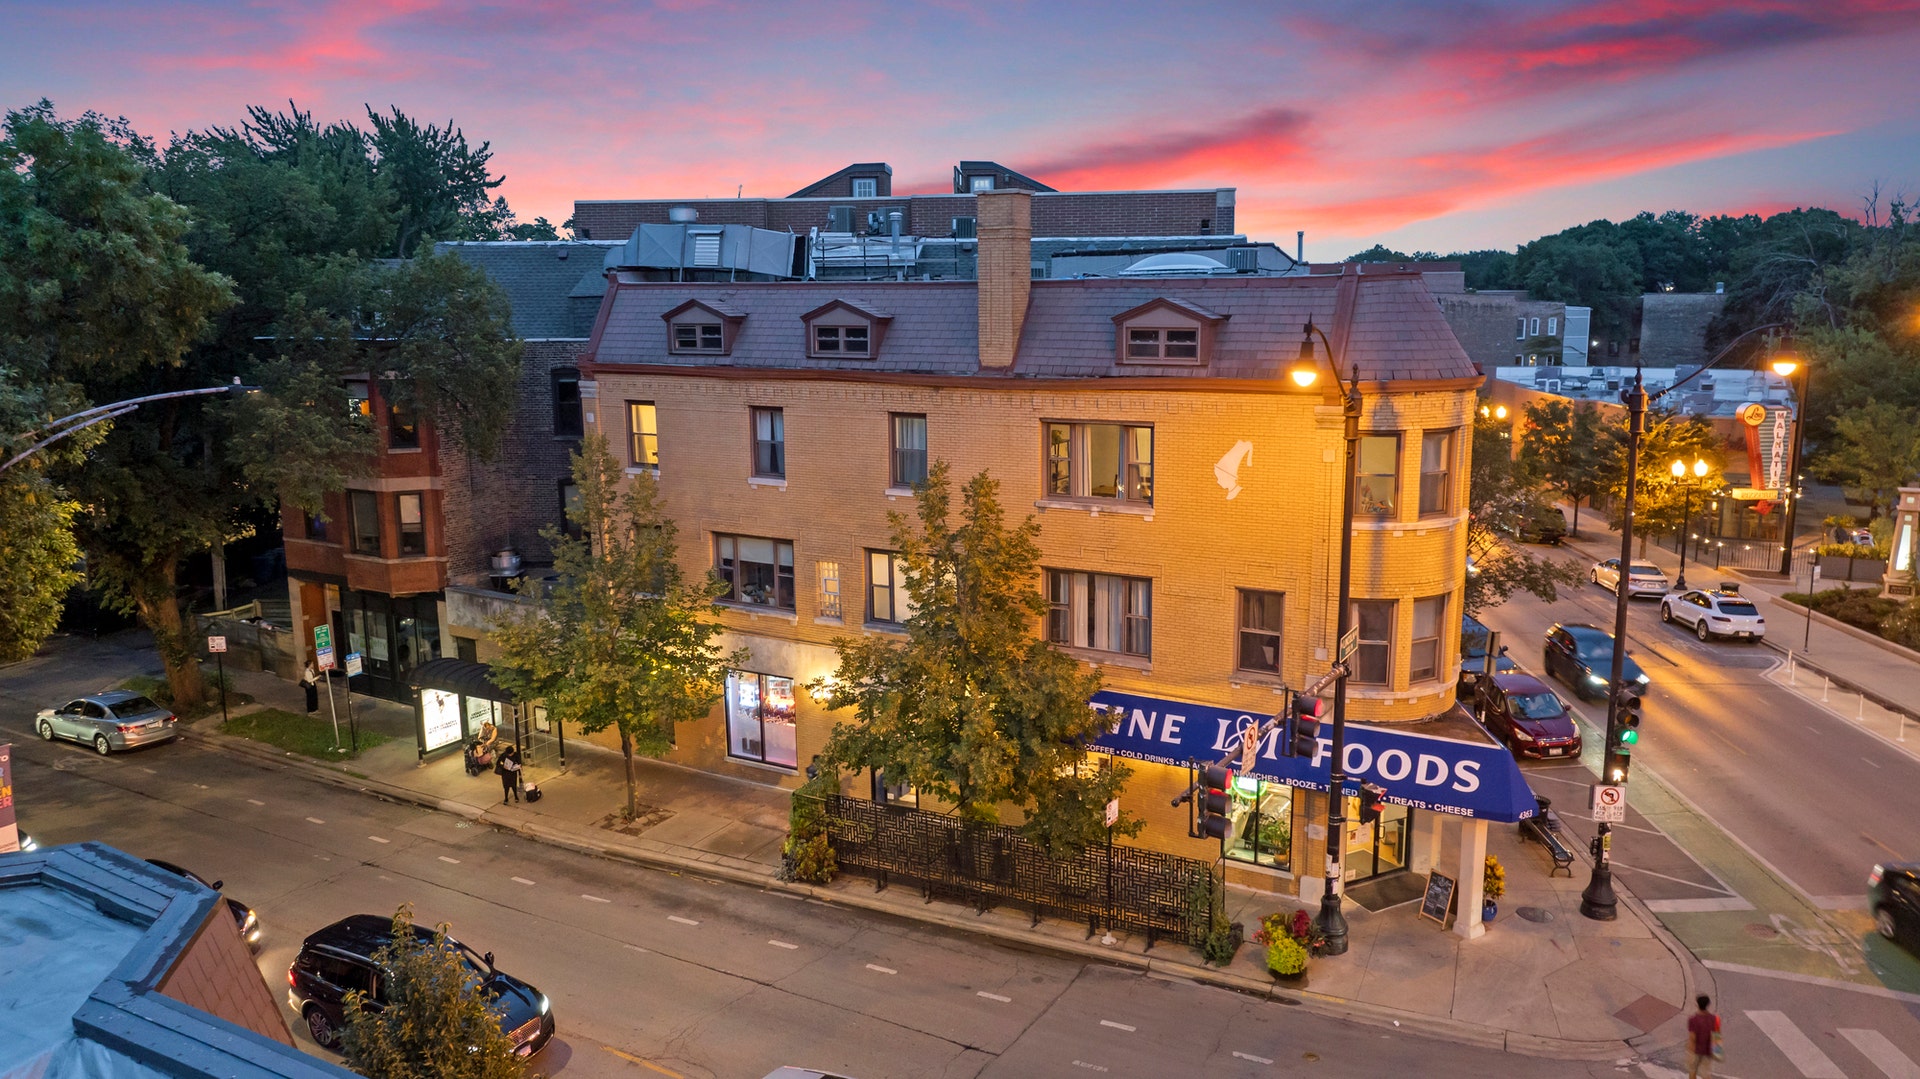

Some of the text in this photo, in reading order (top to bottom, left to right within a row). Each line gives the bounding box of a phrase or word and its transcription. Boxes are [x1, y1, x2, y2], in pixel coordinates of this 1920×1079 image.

[1085, 743, 1115, 756] COFFEE
[1120, 749, 1143, 760] COLD
[1144, 753, 1175, 766] DRINKS
[1286, 777, 1317, 790] BOOZE
[1388, 795, 1426, 810] TREATS
[1433, 803, 1474, 817] CHEESE
[1311, 737, 1481, 793] FOODS
[1518, 809, 1533, 820] 4363
